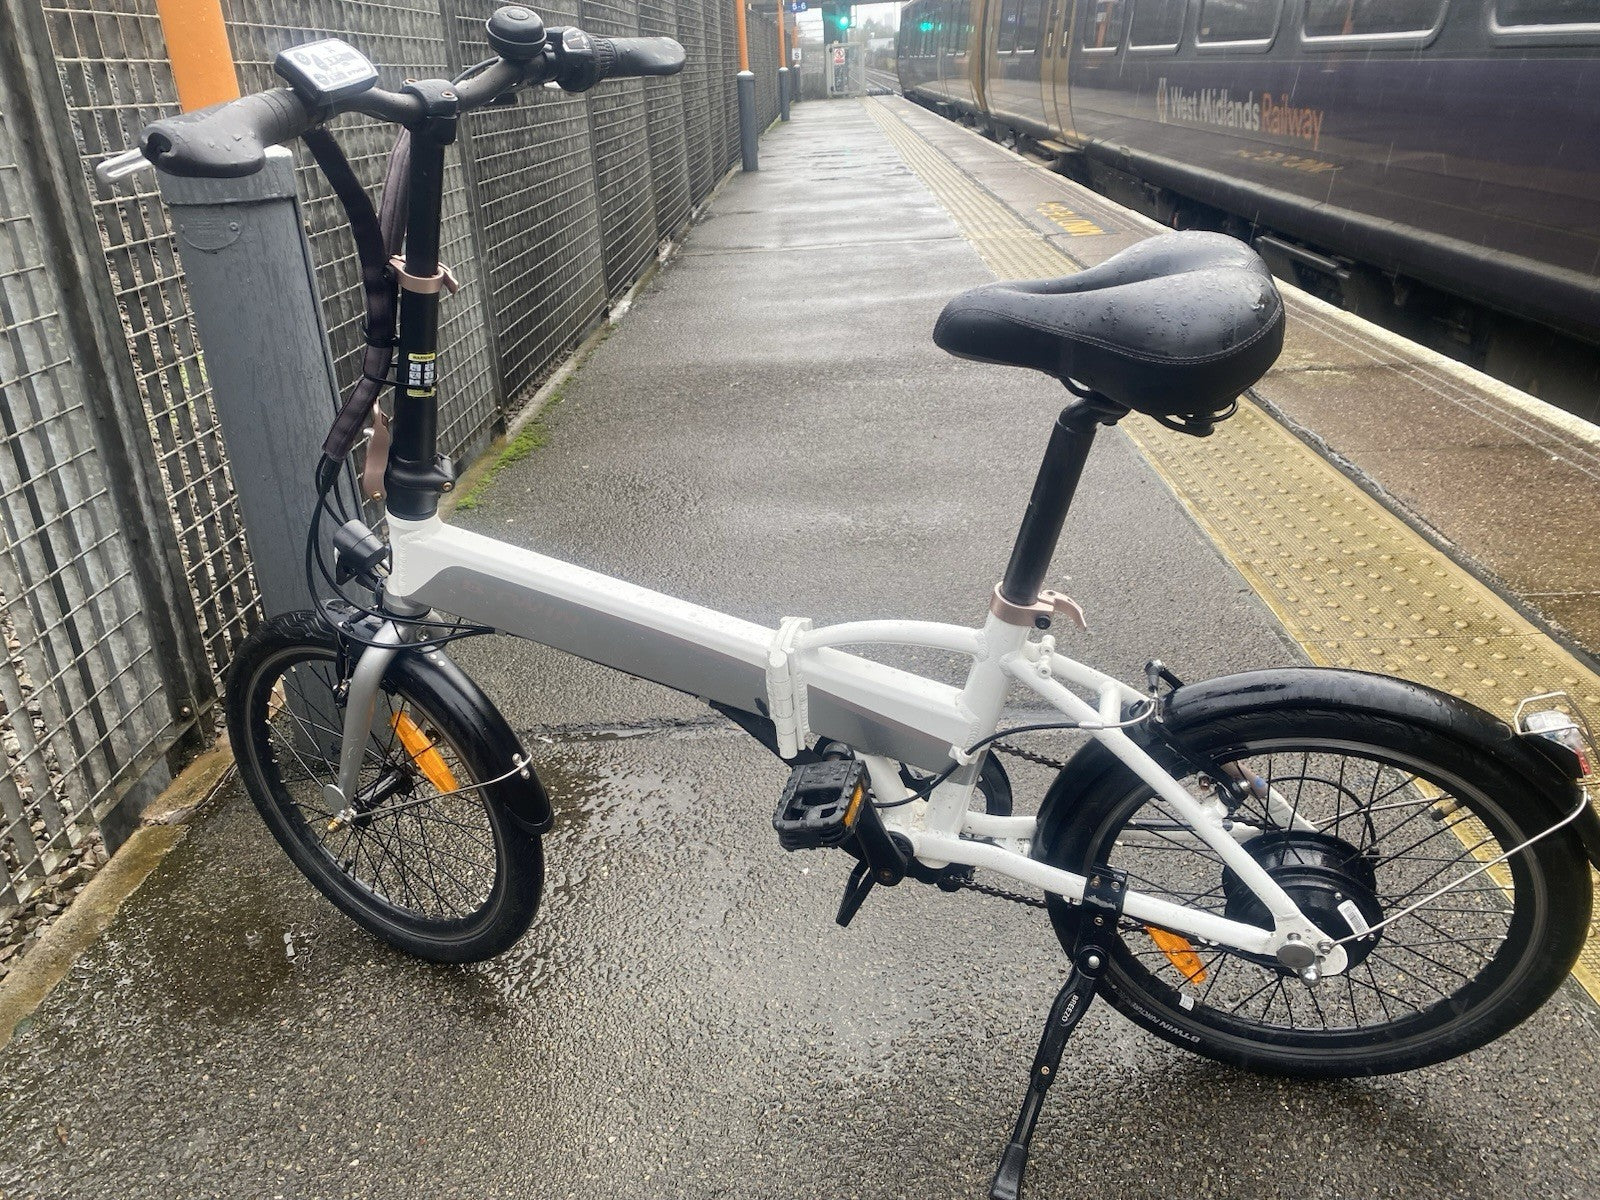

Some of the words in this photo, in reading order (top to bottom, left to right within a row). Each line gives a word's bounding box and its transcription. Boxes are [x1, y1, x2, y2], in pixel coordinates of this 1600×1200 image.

[1170, 87, 1198, 121] West
[1200, 89, 1260, 132] Midlands
[1261, 93, 1324, 150] Railway
[1062, 995, 1079, 1022] BREEZO
